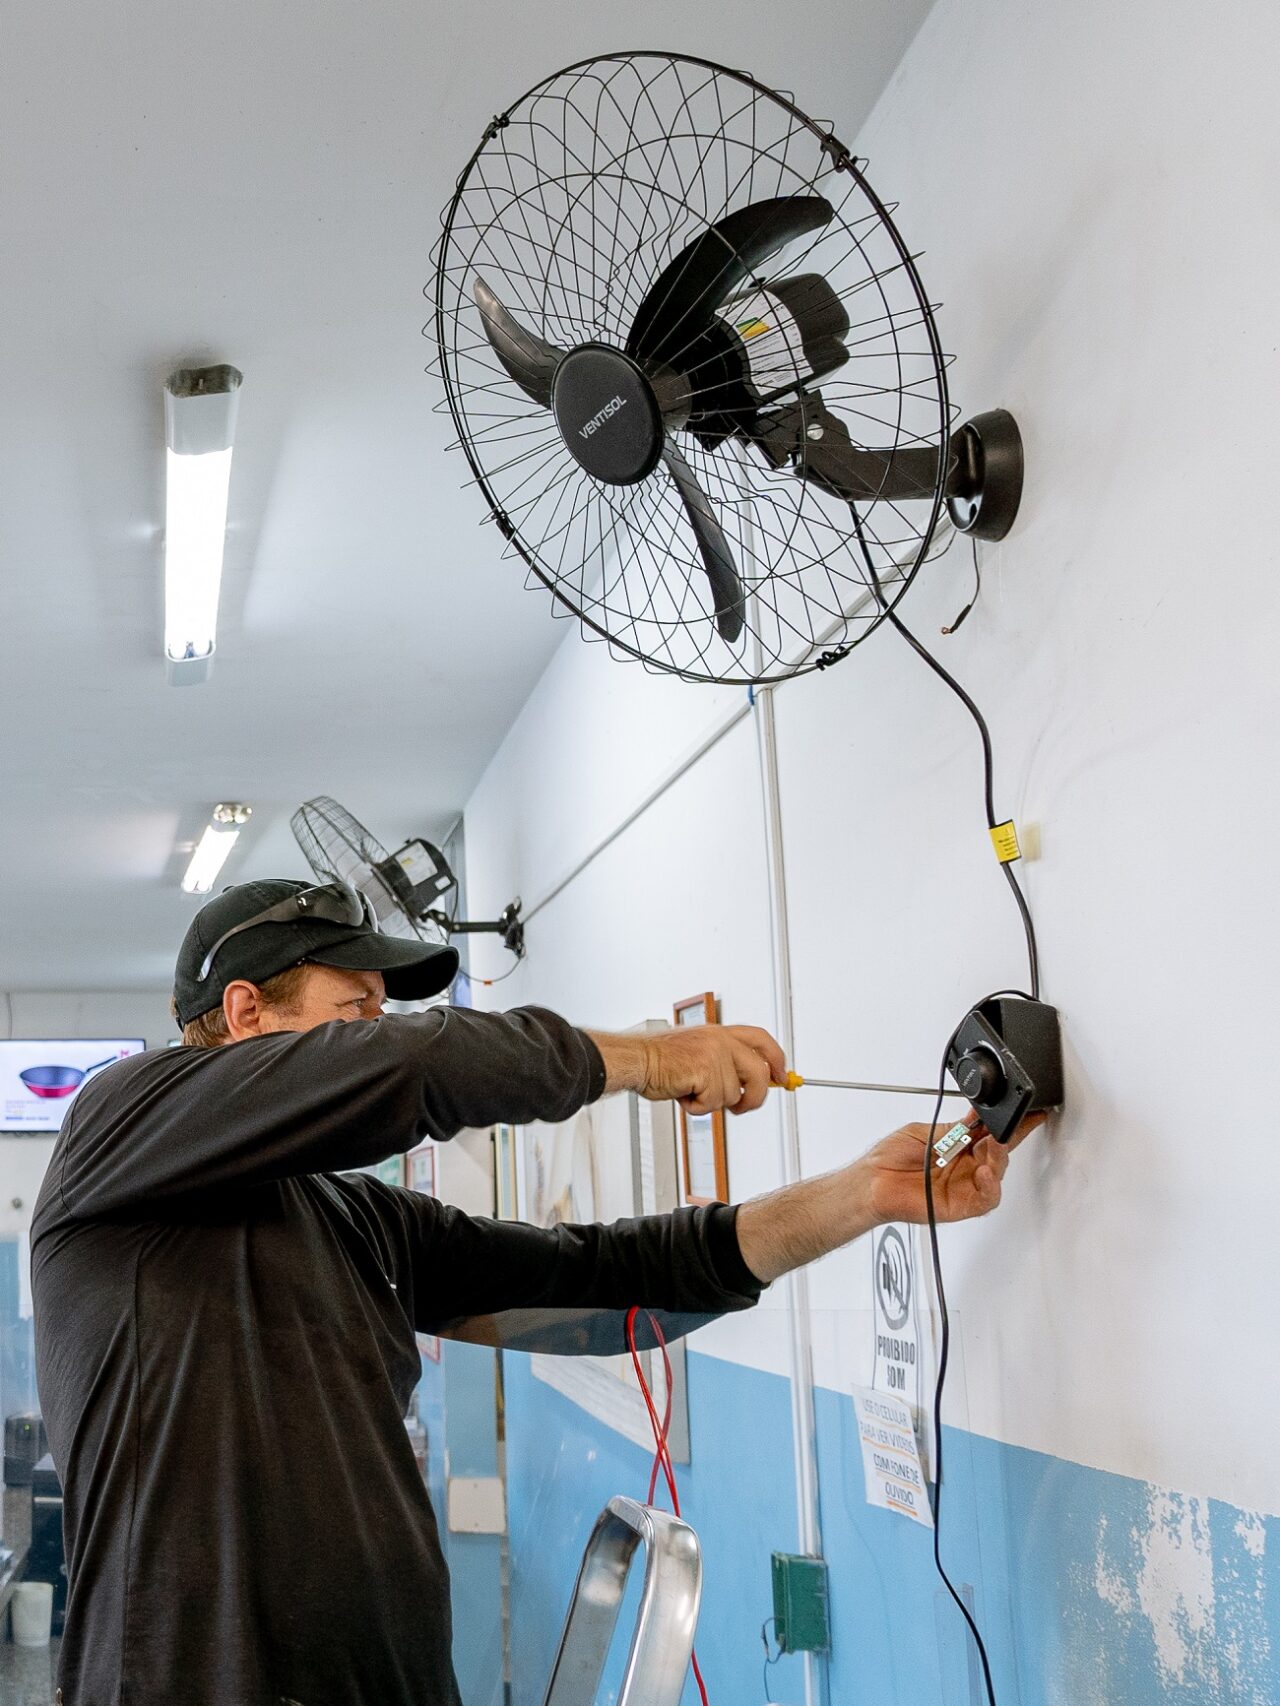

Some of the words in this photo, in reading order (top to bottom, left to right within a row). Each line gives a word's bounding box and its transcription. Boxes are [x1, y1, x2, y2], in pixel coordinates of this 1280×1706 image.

[578, 395, 628, 440] VENTISOL
[877, 1334, 916, 1366] PROIBIDO
[873, 1453, 890, 1472] COM
[890, 1459, 911, 1480] FONE
[884, 1481, 915, 1506] OUVIDO
